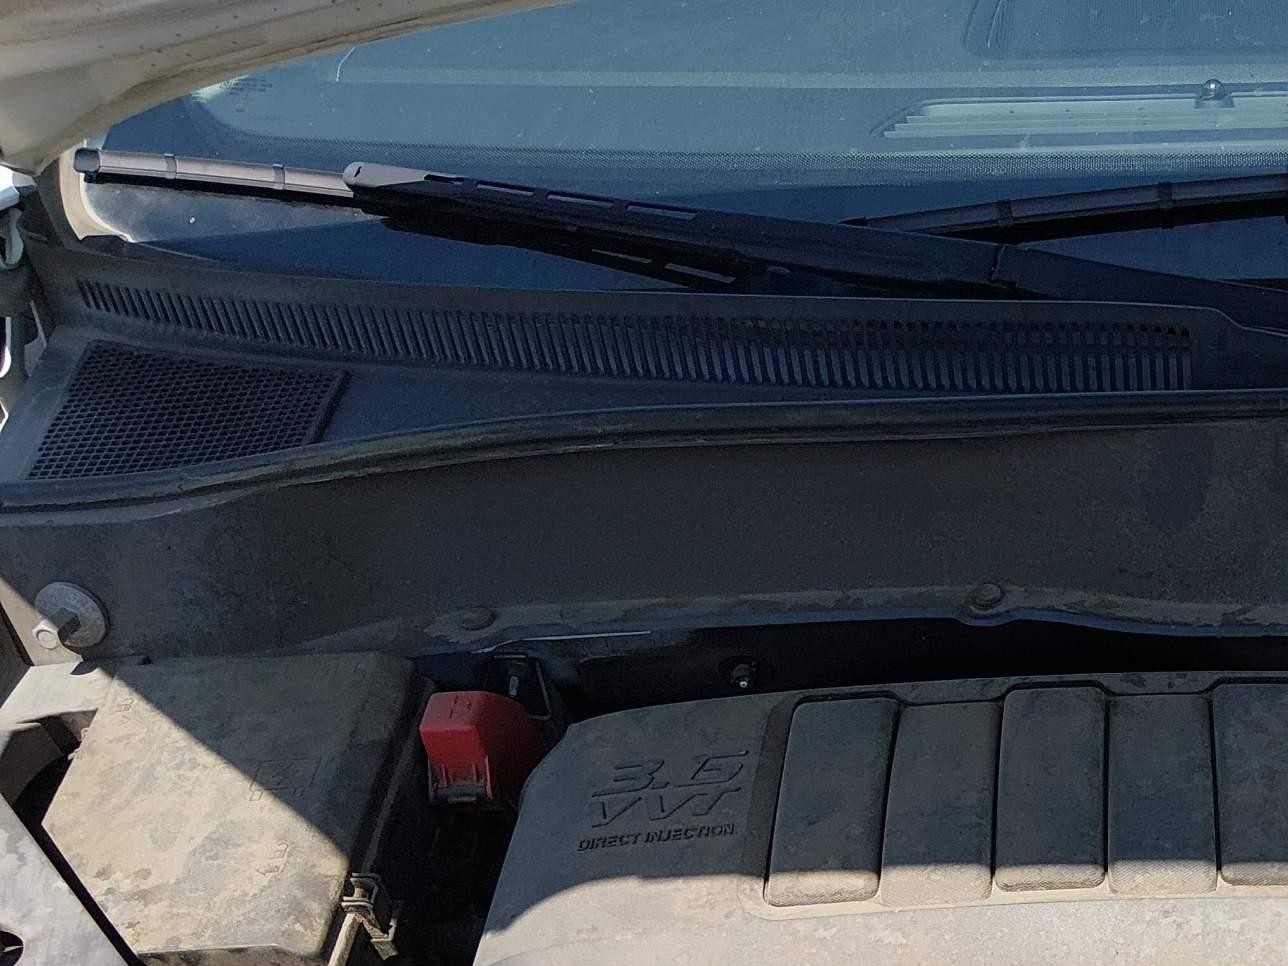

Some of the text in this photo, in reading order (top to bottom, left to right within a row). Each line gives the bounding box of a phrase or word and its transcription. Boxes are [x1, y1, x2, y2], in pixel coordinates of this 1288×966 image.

[592, 749, 749, 797] 3.6
[591, 787, 741, 828] VVT
[577, 823, 737, 852] DIRECT INJECTION
